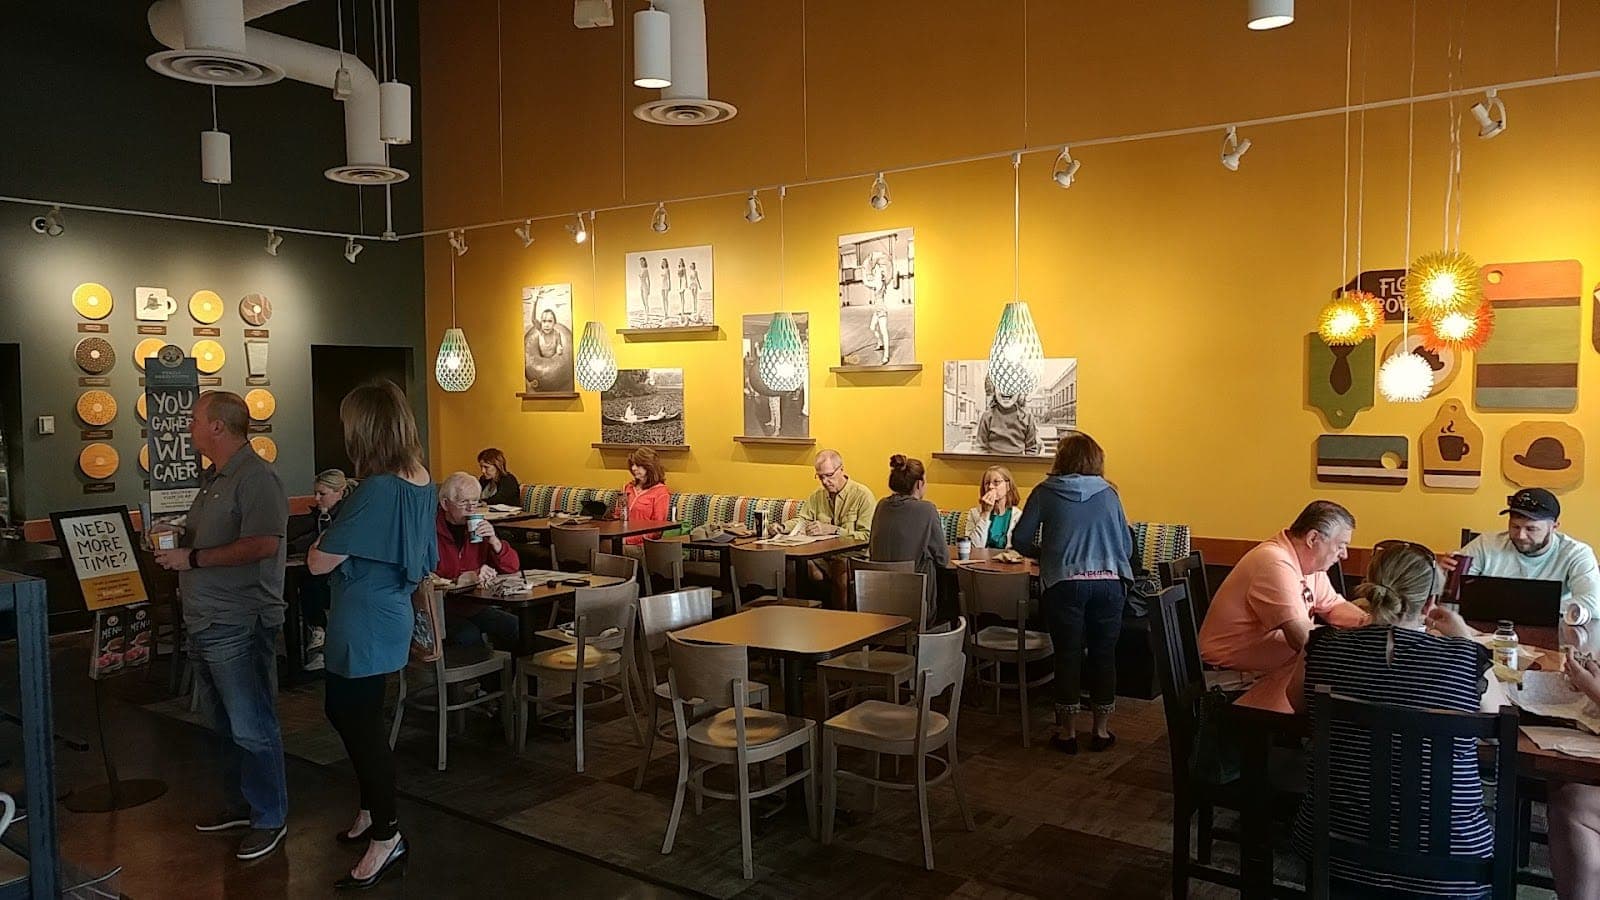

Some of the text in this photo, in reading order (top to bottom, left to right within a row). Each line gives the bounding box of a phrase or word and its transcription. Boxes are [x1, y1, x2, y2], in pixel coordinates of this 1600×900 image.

[152, 389, 193, 414] YOU
[153, 432, 195, 461] WE
[153, 461, 199, 482] CATER
[72, 520, 116, 537] NEED
[77, 536, 123, 554] MORE
[78, 551, 128, 572] TIME?
[101, 624, 123, 640] MENU
[130, 616, 153, 633] MENU
